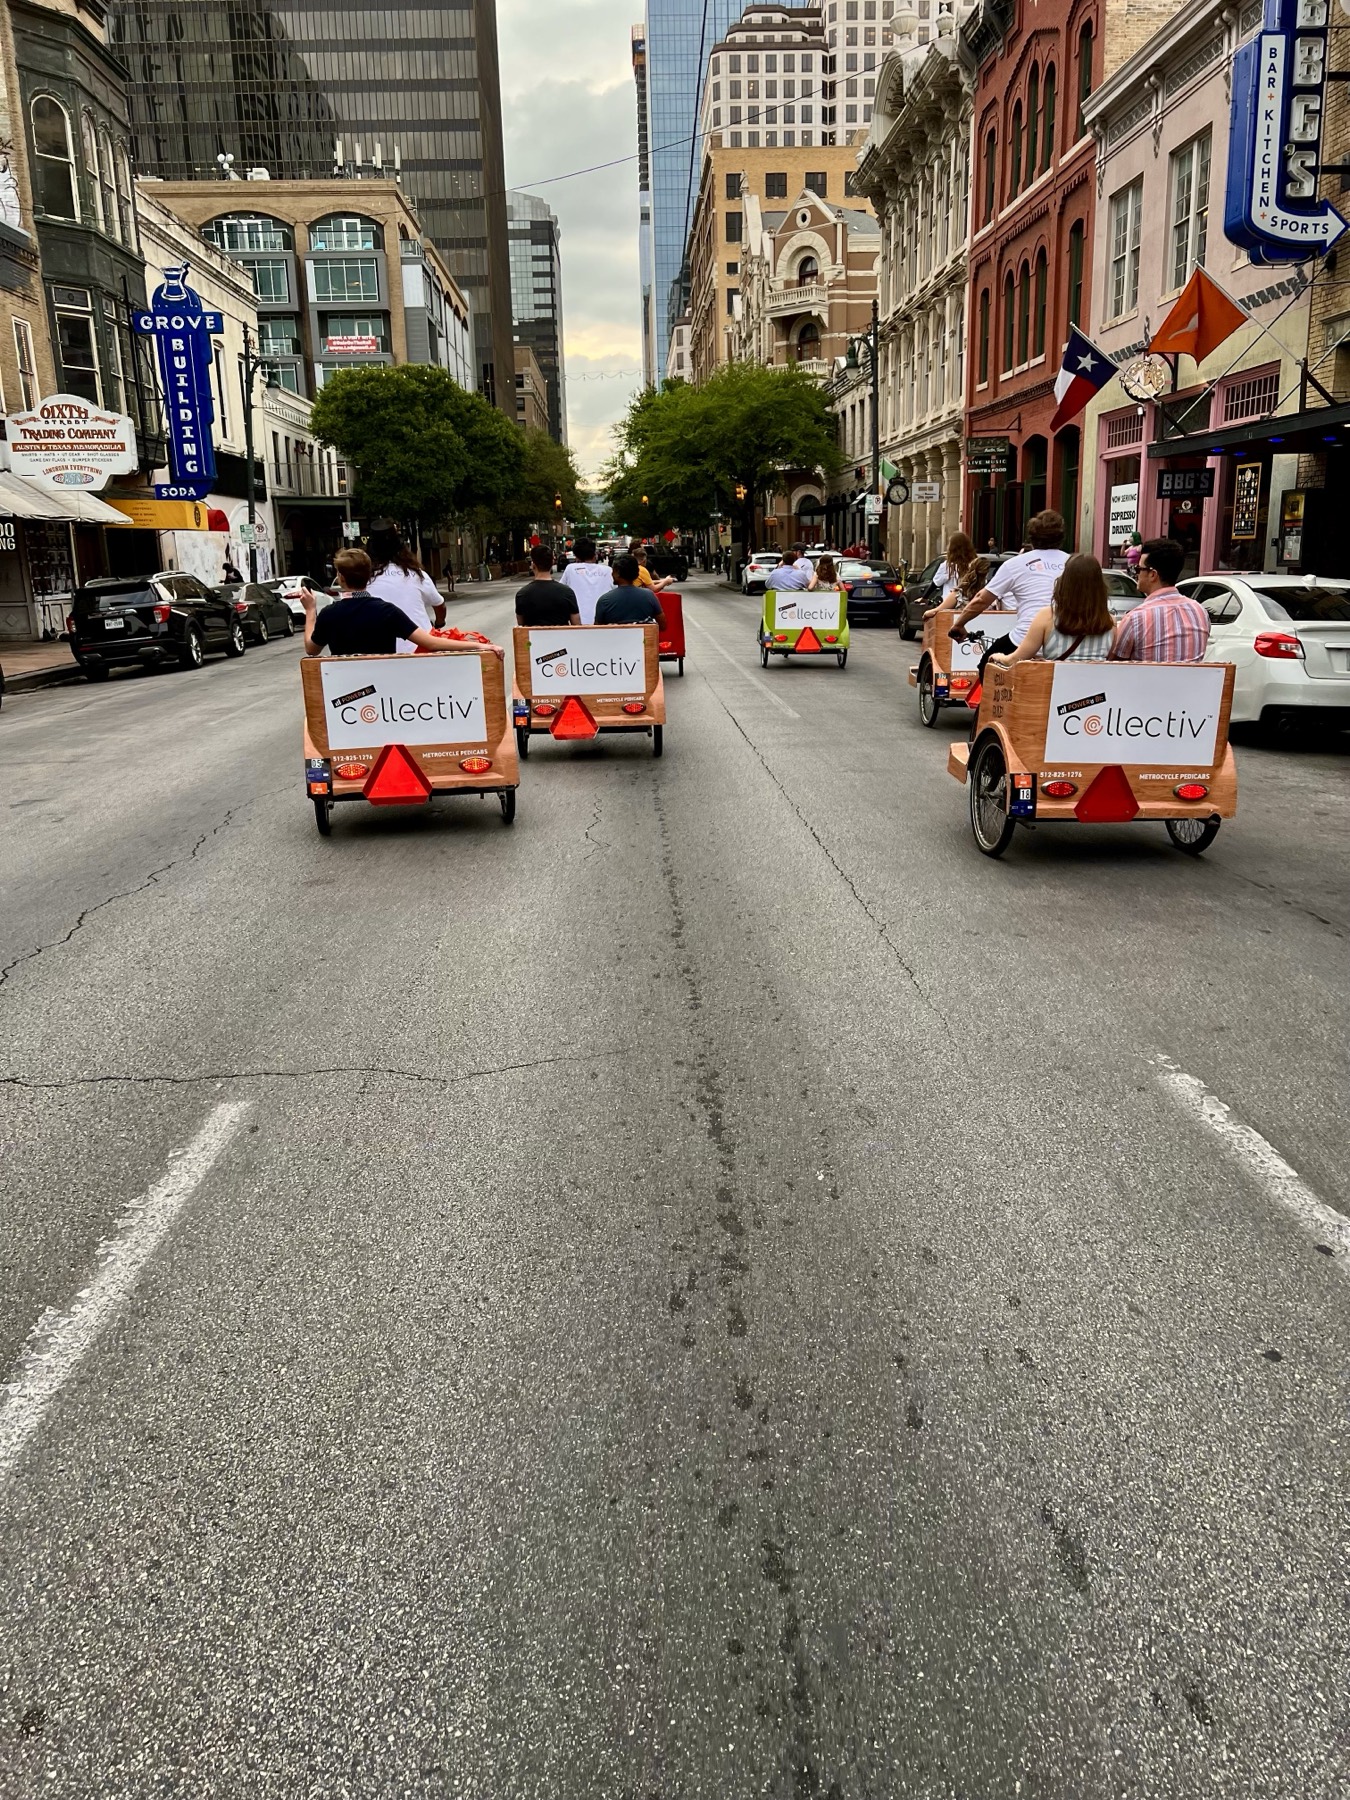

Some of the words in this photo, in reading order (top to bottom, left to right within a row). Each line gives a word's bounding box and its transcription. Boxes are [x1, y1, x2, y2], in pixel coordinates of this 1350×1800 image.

[1267, 47, 1278, 88] BAR
[1259, 109, 1274, 208] KITCHEN
[1270, 215, 1329, 234] SPORTS
[140, 315, 216, 330] GROVE
[171, 338, 198, 473] BUILDING
[20, 428, 65, 441] TRADING
[67, 428, 117, 440] COMPANY
[1162, 473, 1210, 489] BBG'S
[161, 487, 197, 497] SODA
[1121, 493, 1137, 503] SERVING
[1111, 510, 1136, 521] ESPRESSO
[460, 748, 488, 756] PEDICABS
